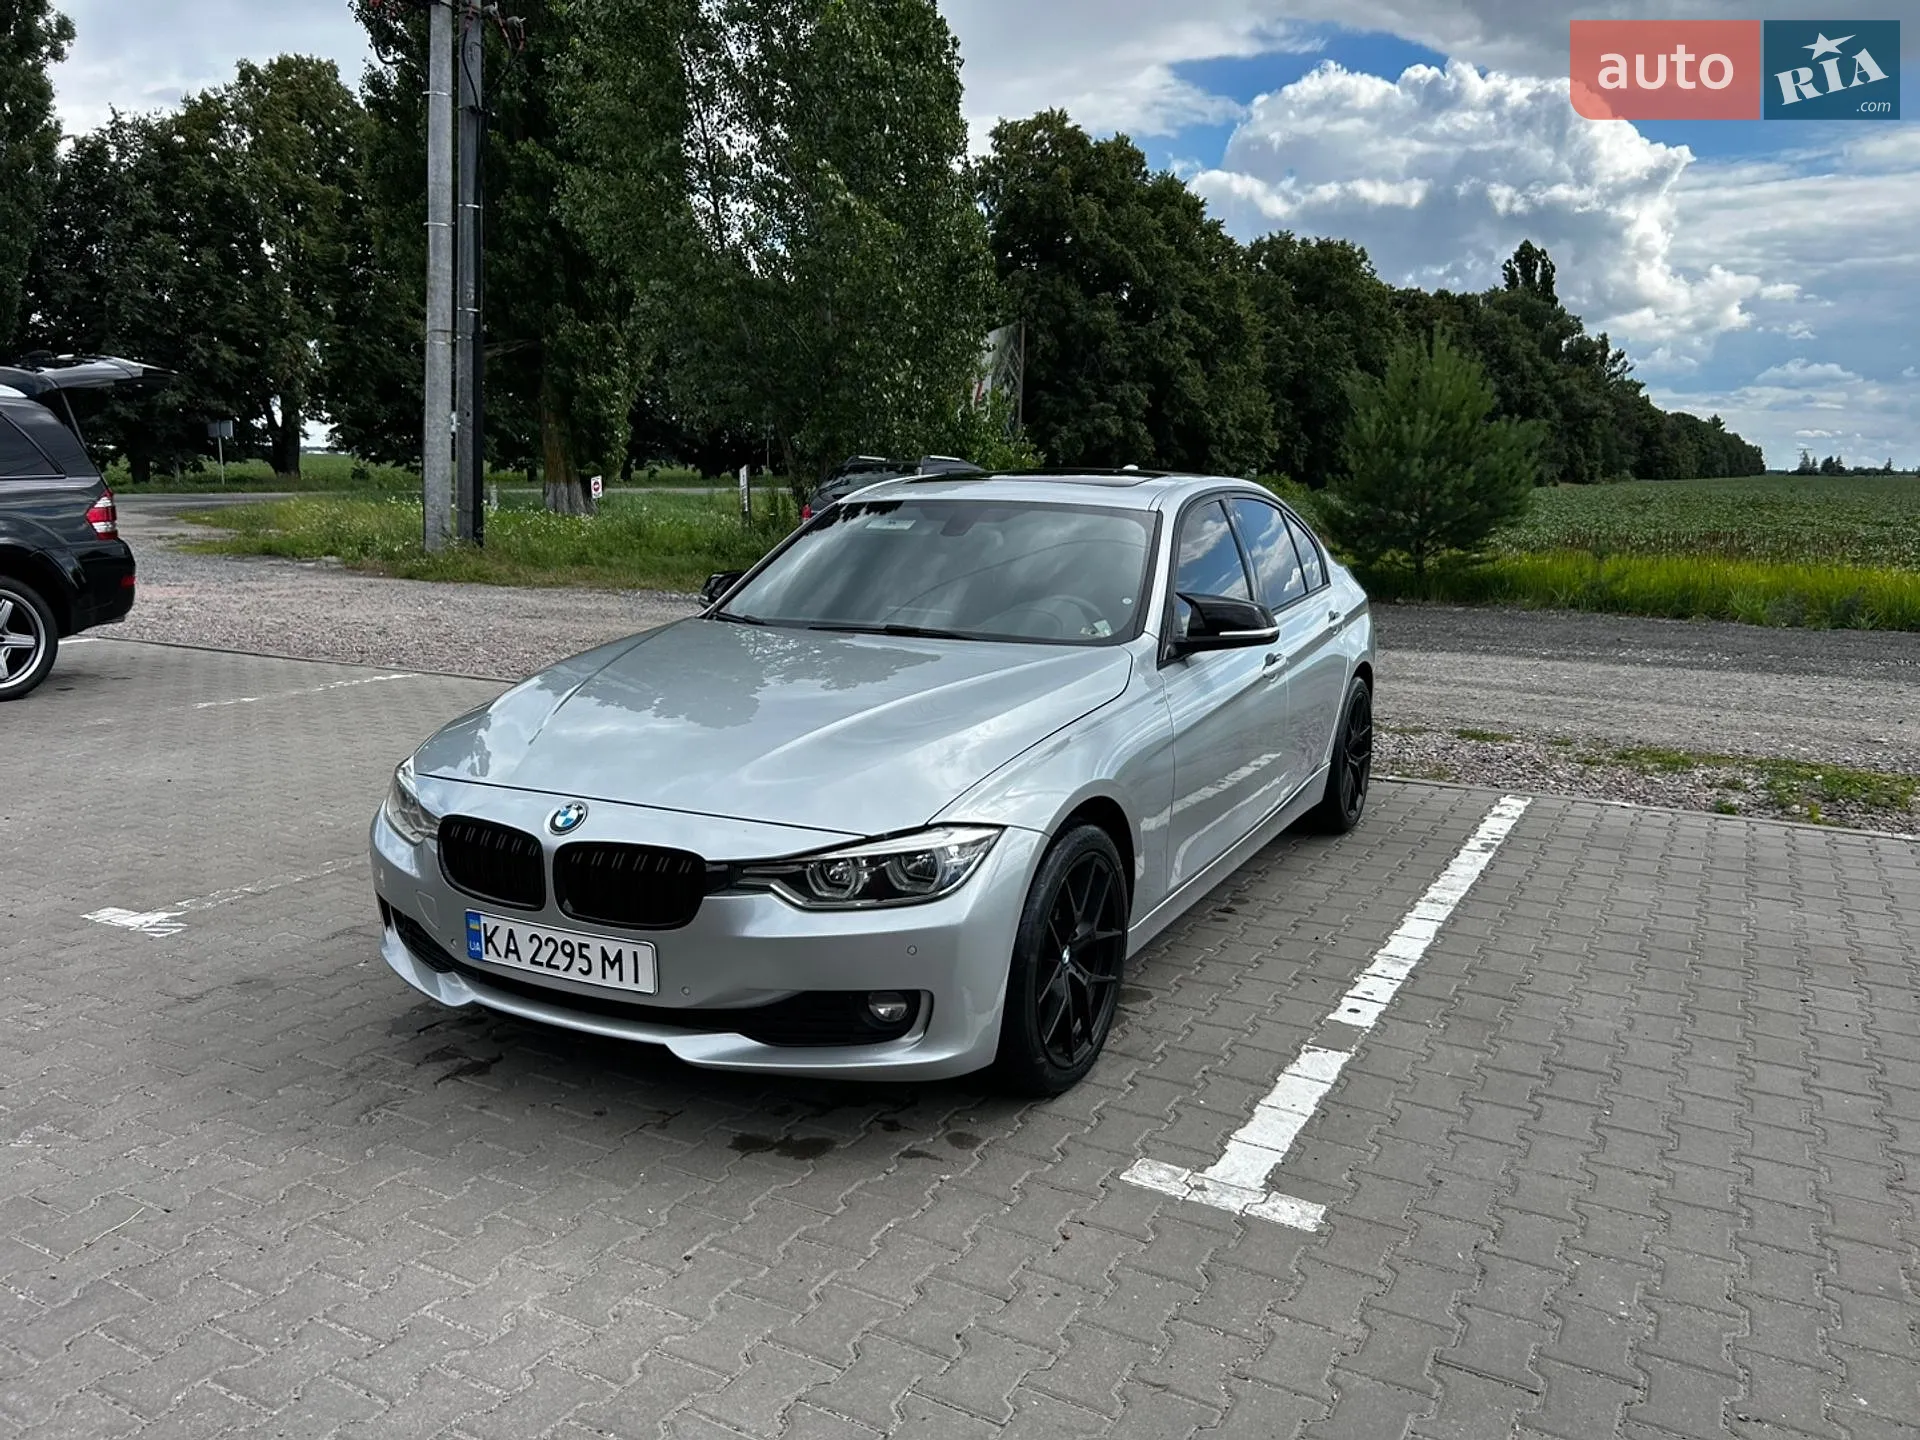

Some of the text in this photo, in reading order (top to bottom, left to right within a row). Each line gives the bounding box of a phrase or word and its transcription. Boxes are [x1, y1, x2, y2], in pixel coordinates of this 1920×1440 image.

[469, 940, 481, 952] UA
[483, 922, 639, 984] KA 2295 MI
